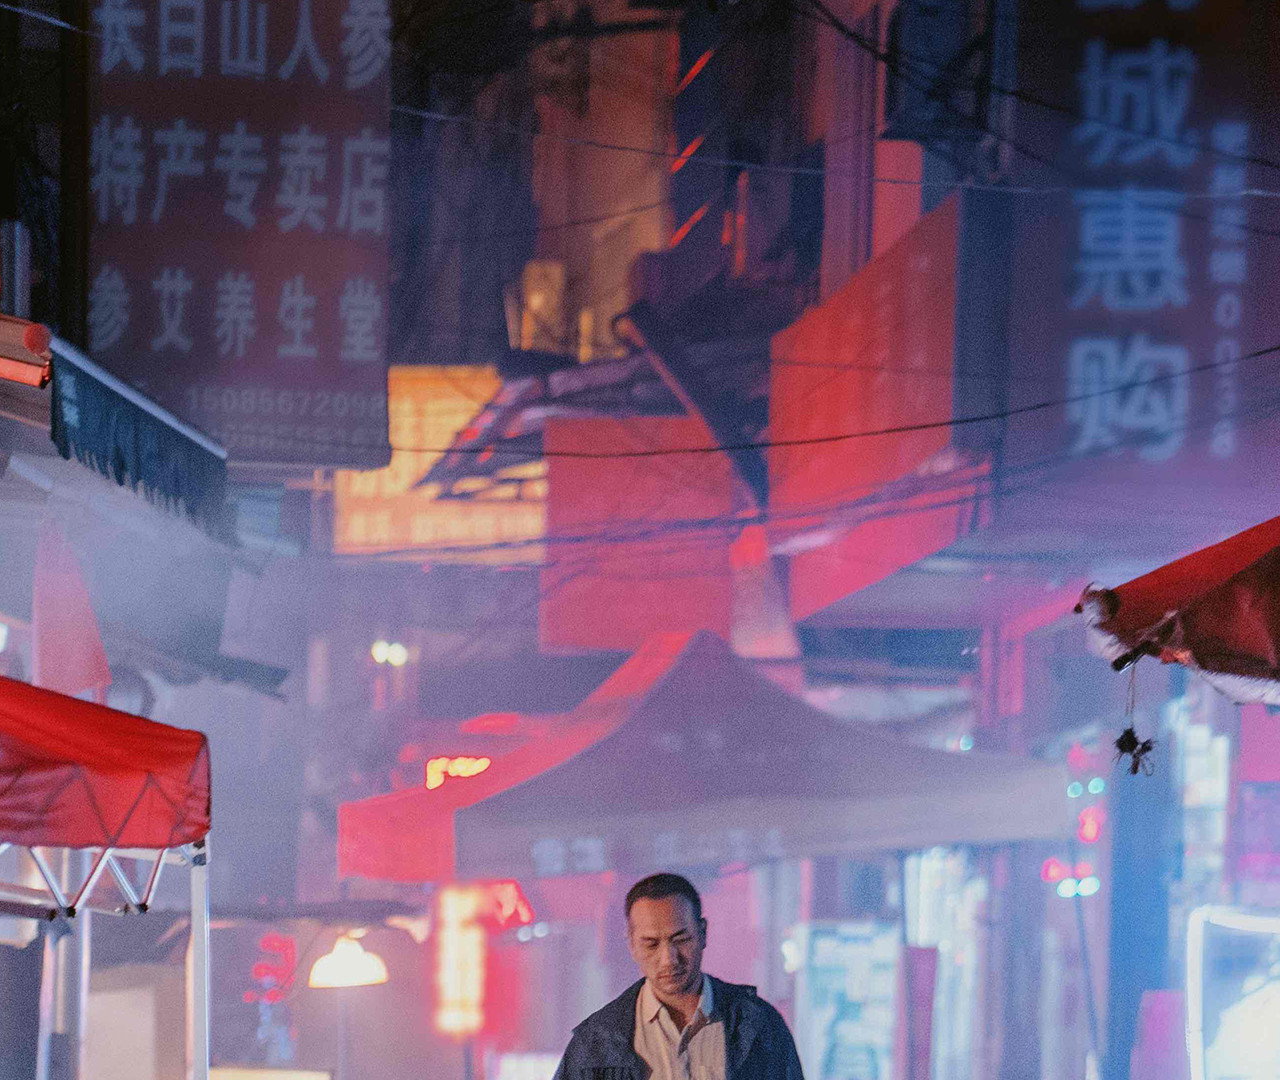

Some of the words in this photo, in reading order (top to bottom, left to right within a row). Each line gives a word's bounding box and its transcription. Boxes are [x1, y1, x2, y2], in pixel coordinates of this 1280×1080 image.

[90, 114, 392, 236] 特产专卖店
[1068, 0, 1200, 464] 城惠购
[88, 264, 382, 363] 参艾养生堂
